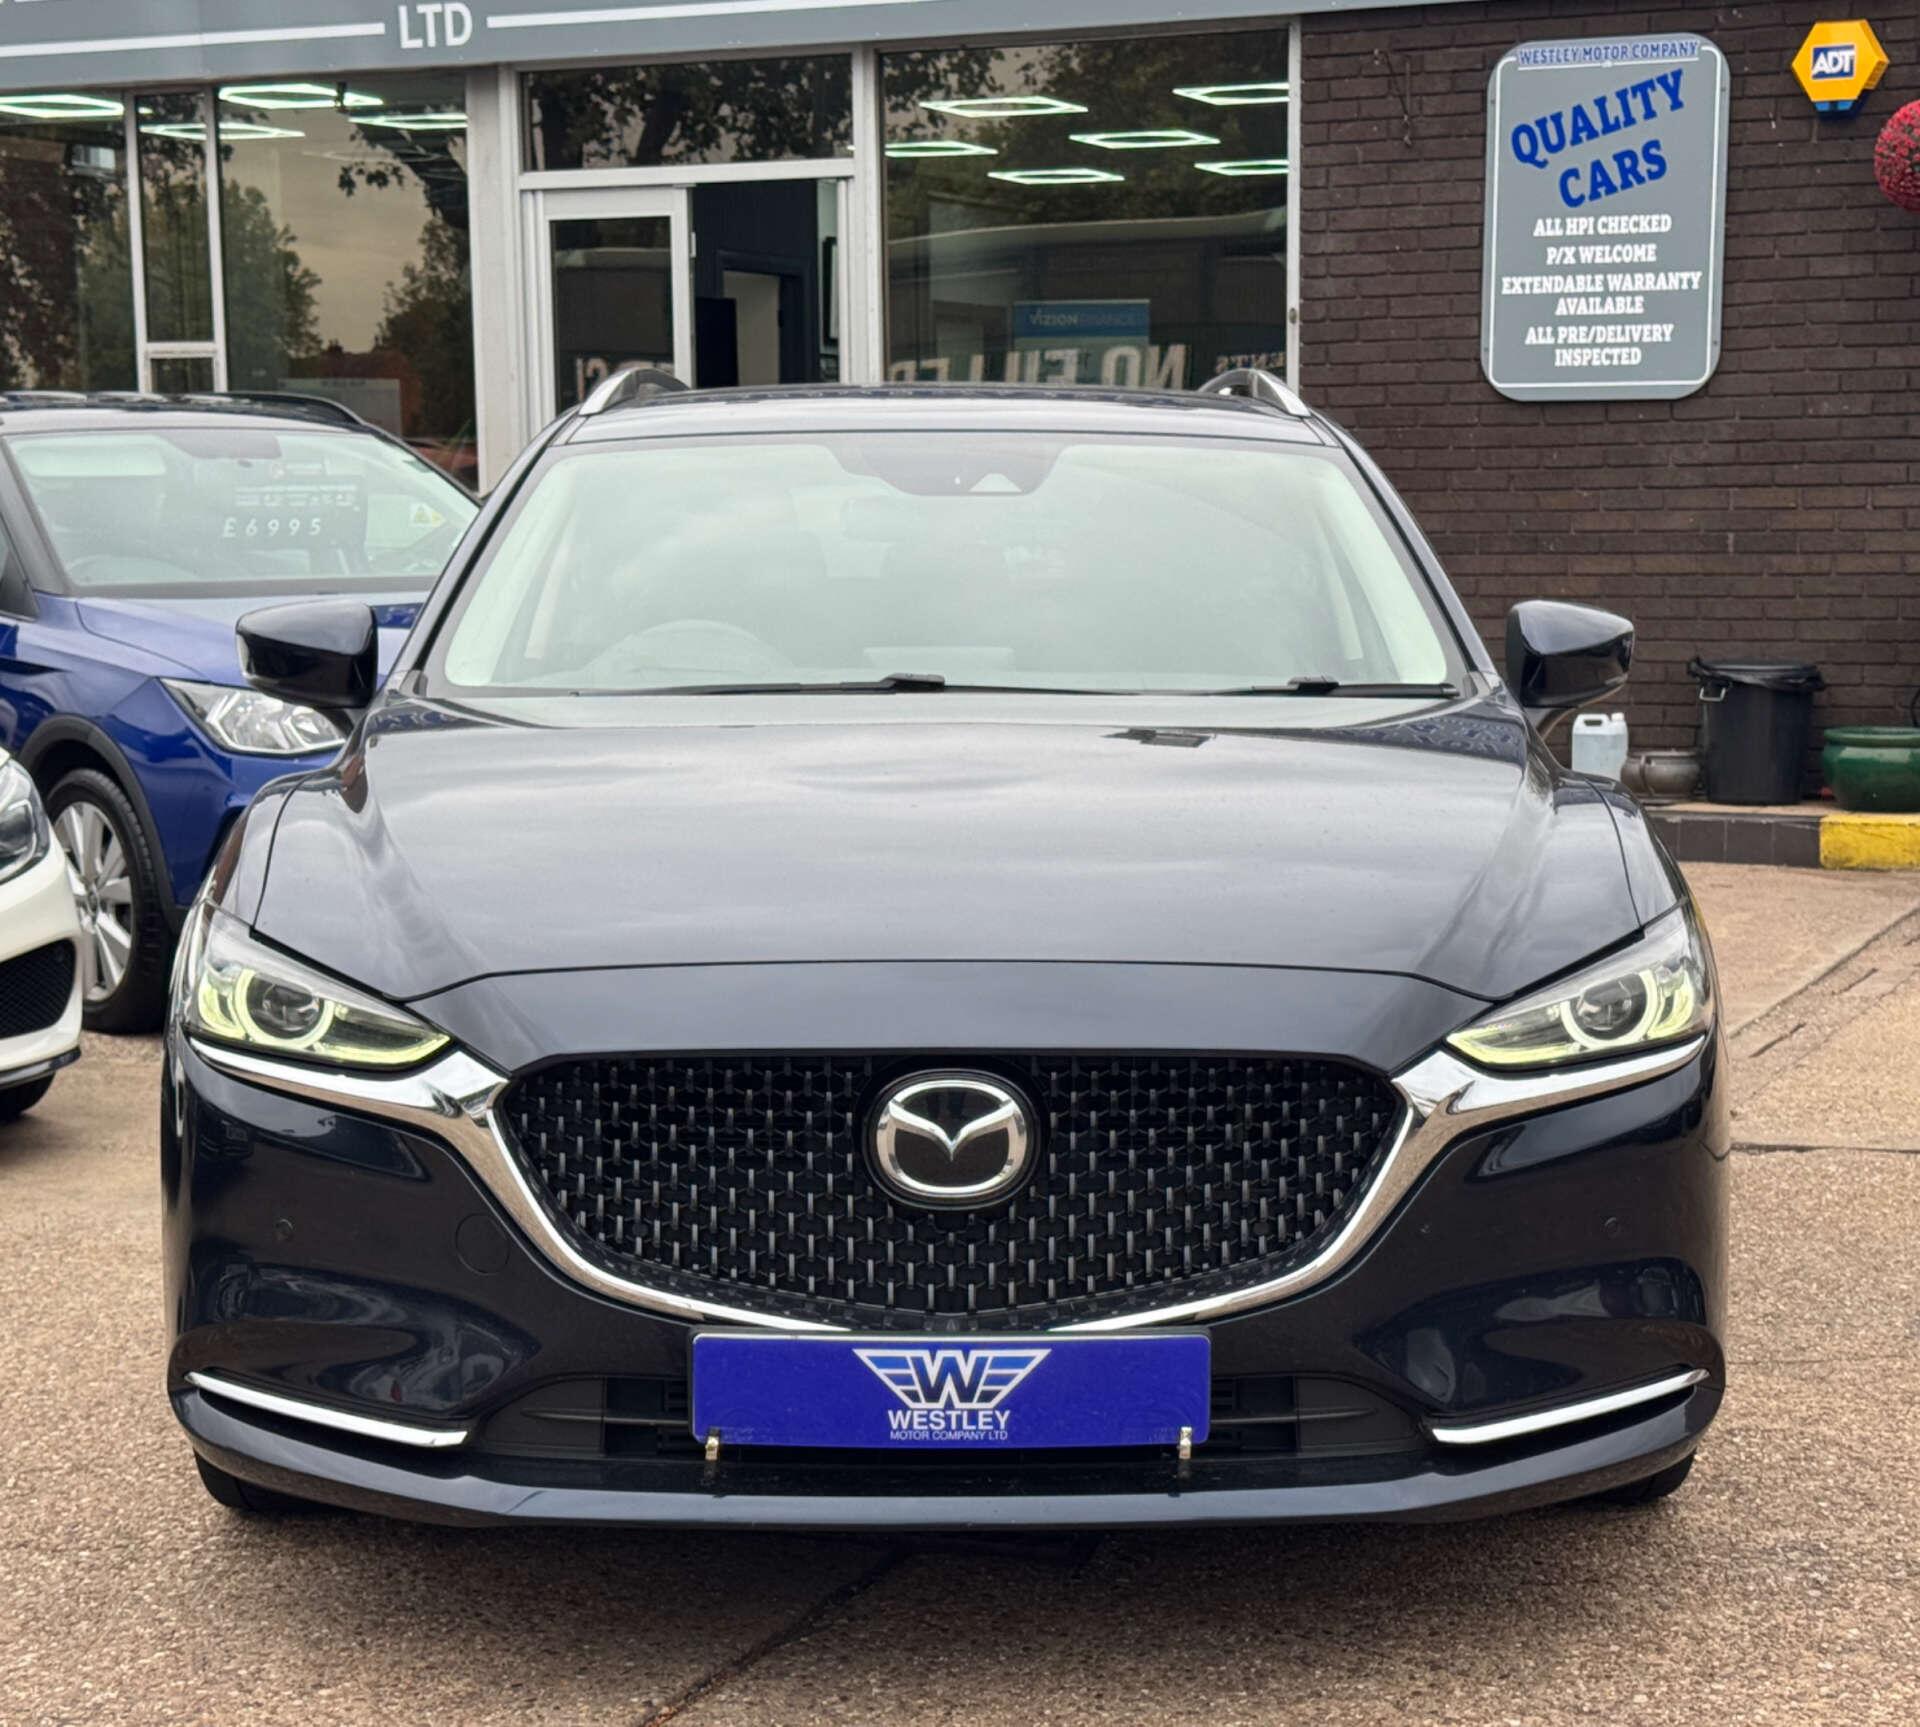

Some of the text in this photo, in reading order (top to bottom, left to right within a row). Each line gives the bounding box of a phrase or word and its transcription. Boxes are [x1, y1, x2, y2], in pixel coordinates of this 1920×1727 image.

[399, 2, 472, 48] LTD
[1519, 41, 1699, 64] WESTLEY MOTOR COMPANY
[1812, 49, 1855, 75] ADT
[1511, 68, 1684, 169] QUALITY
[1559, 139, 1667, 208] CARS
[1533, 214, 1672, 237] ALL HPI CHECKED
[1546, 244, 1657, 265] P/X WELCOME
[1501, 271, 1702, 295] EXTENDABLE WARRANTY
[1555, 296, 1644, 315] AVAILABLE
[1525, 324, 1674, 344] ALL PRE/DELIVERY
[1555, 348, 1641, 366] INSPECTED
[888, 1410, 1010, 1430] WESTLEY
[890, 1430, 1008, 1441] MOTOR COMPANY LTD
